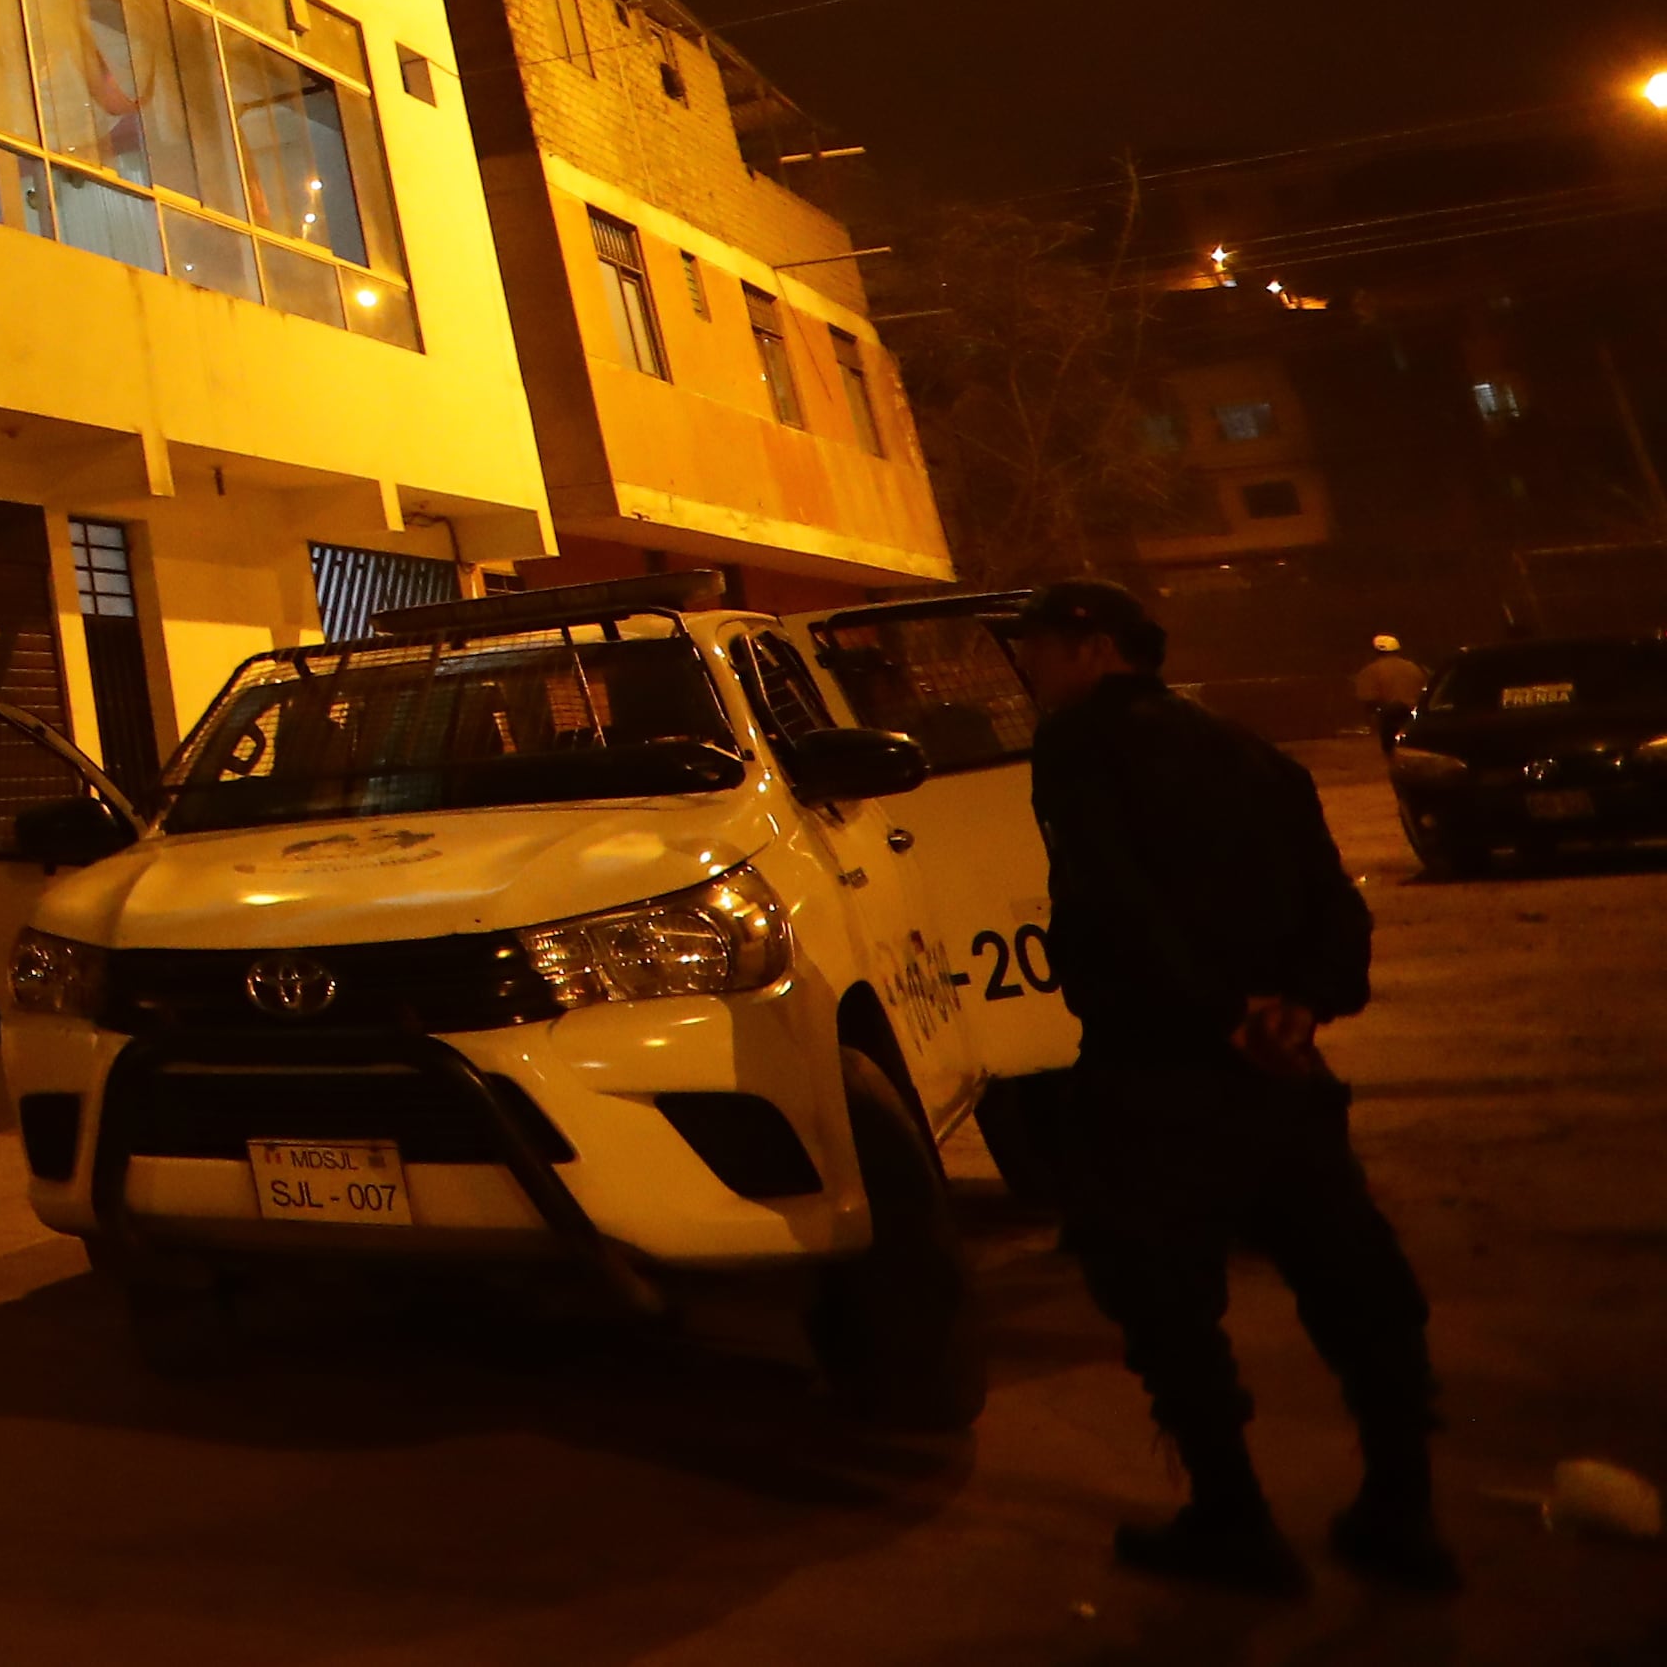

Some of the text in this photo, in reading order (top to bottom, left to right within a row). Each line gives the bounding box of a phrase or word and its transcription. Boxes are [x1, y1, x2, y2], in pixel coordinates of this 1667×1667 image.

[1502, 688, 1572, 710] PRENSA
[291, 1150, 360, 1171] MDSJL
[271, 1180, 324, 1209] SJL
[347, 1183, 397, 1212] 007
